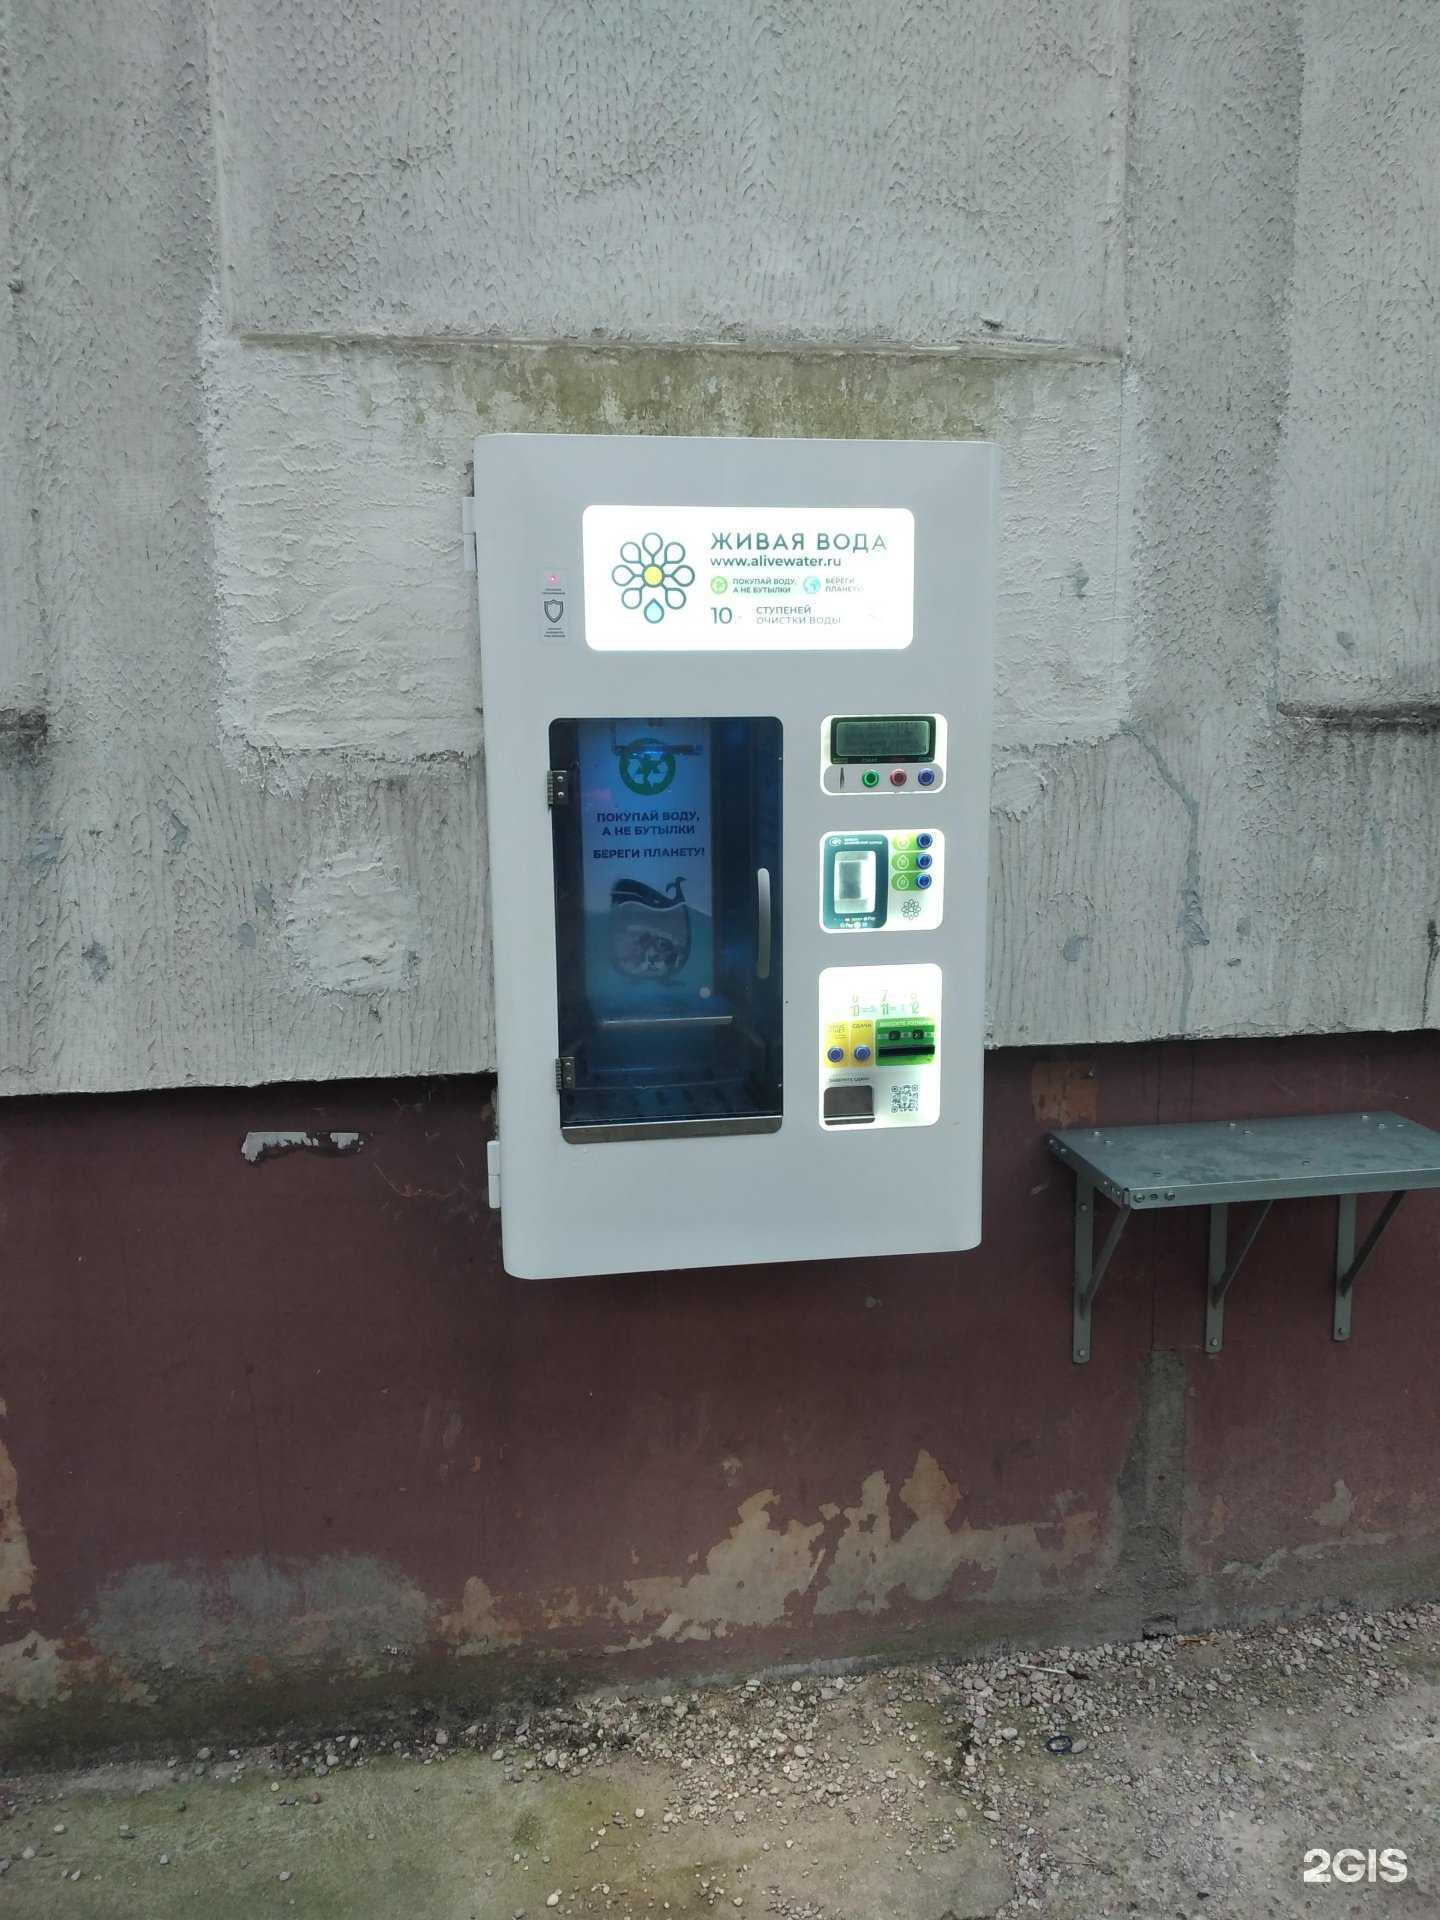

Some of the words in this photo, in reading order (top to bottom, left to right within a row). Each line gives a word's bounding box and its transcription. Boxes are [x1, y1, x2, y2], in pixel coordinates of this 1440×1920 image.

[711, 532, 805, 551] ЖИВАЯ
[816, 533, 888, 554] ВОДА
[710, 554, 842, 568] www.alivewater.ru
[732, 576, 772, 585] ПОКУПАЙ
[732, 586, 739, 594] А
[740, 586, 751, 594] НЕ
[753, 585, 792, 594] БУТЫЛКИ
[711, 606, 733, 624] 10
[756, 604, 813, 615] СТУПЕНЕЙ
[756, 616, 806, 625] ОЧИСТКИ
[809, 616, 842, 626] ВОДЫ
[597, 811, 659, 823] ПОКУПАЙ
[662, 811, 700, 822] ВОДУ,
[602, 826, 611, 836] А
[614, 826, 632, 836] НЕ
[634, 824, 696, 836] БУТЫЛКИ
[592, 848, 640, 859] БЕРЕГИ
[643, 847, 705, 858] ПЛАНЕТУ!
